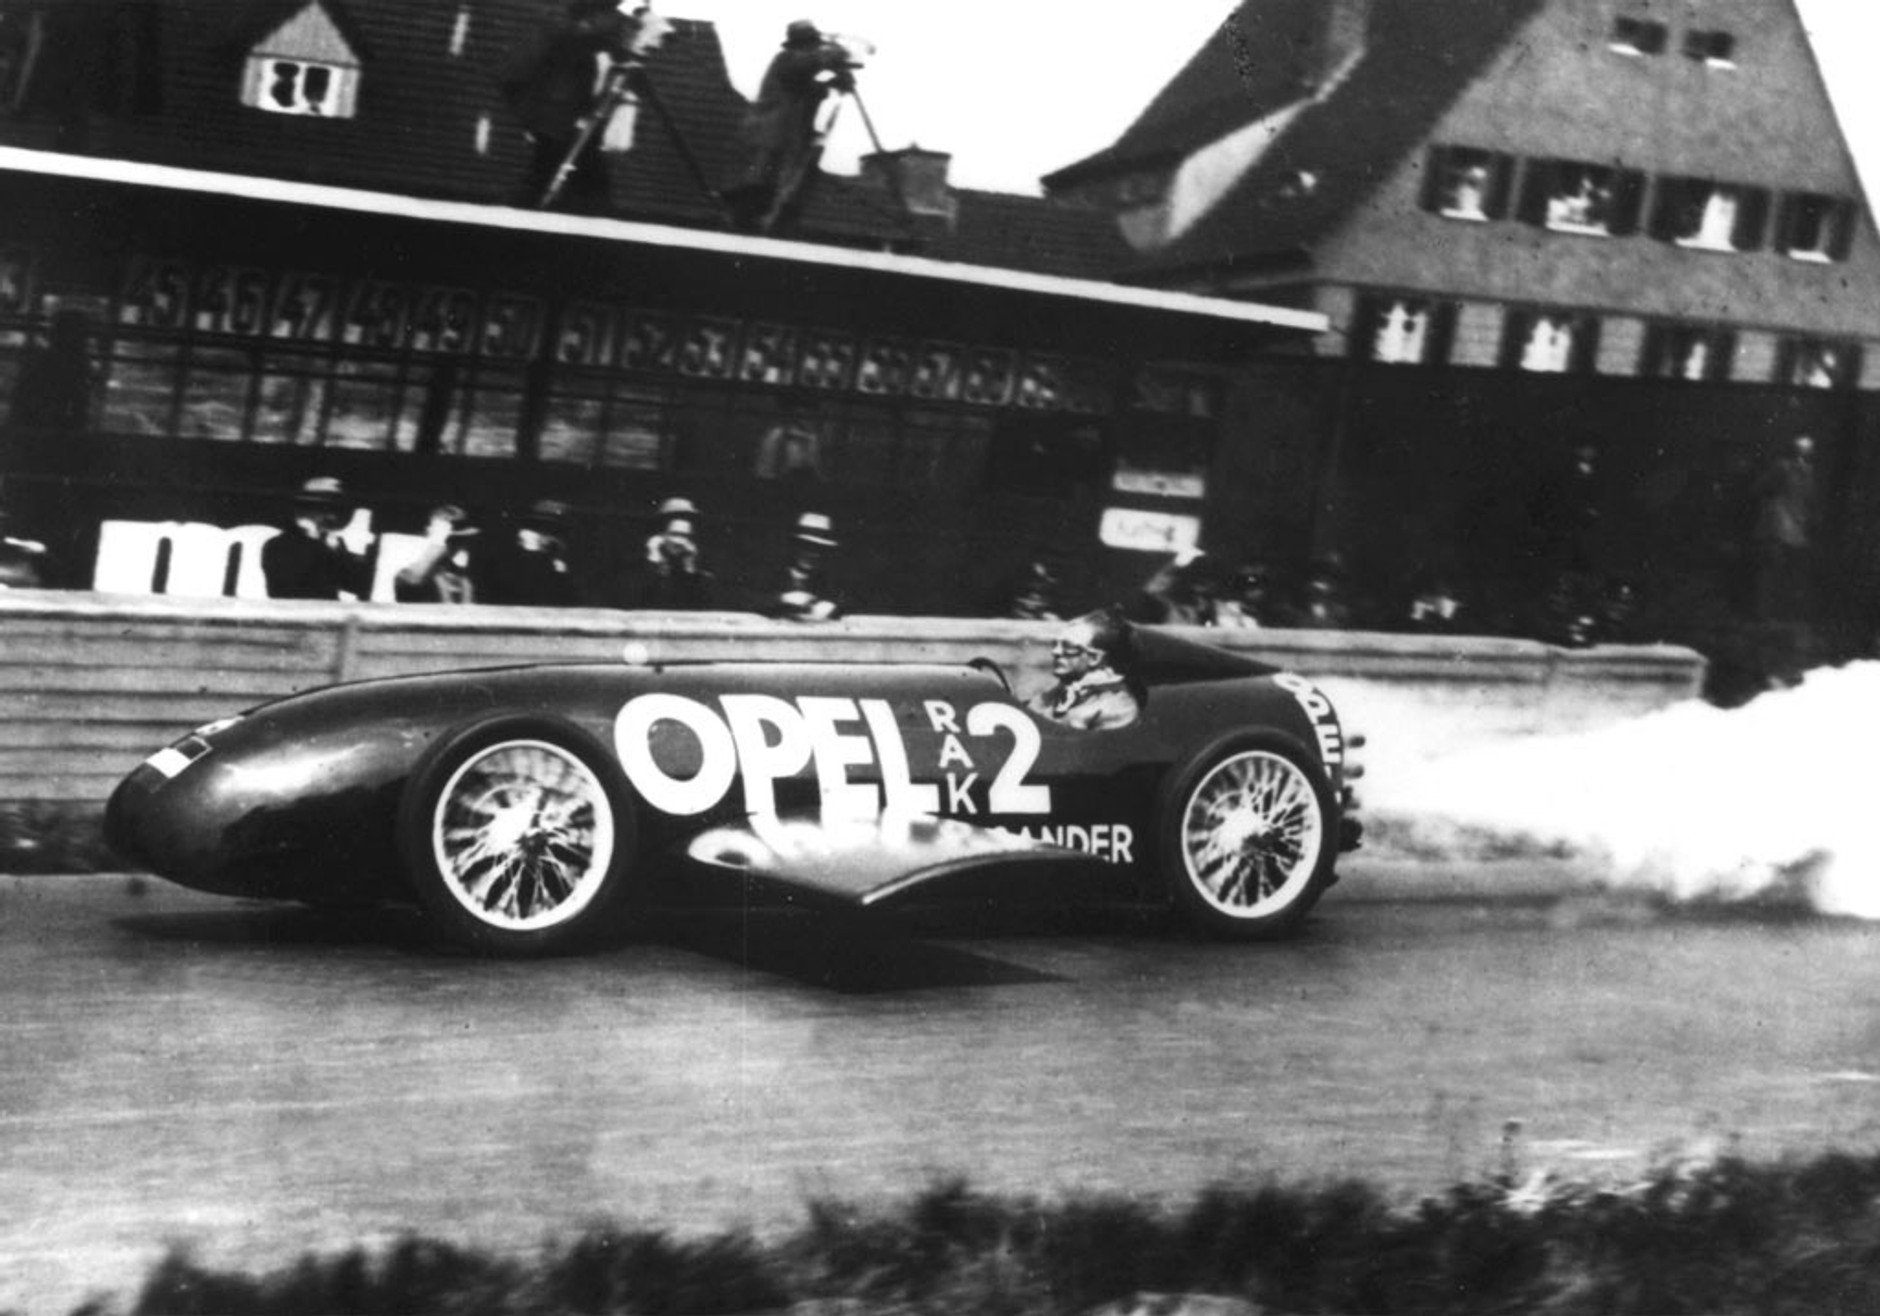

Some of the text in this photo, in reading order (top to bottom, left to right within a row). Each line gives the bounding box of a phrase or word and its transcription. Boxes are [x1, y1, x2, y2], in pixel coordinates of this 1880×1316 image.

[614, 692, 1051, 816] OPEL RAK 2
[990, 823, 1134, 863] NDER
